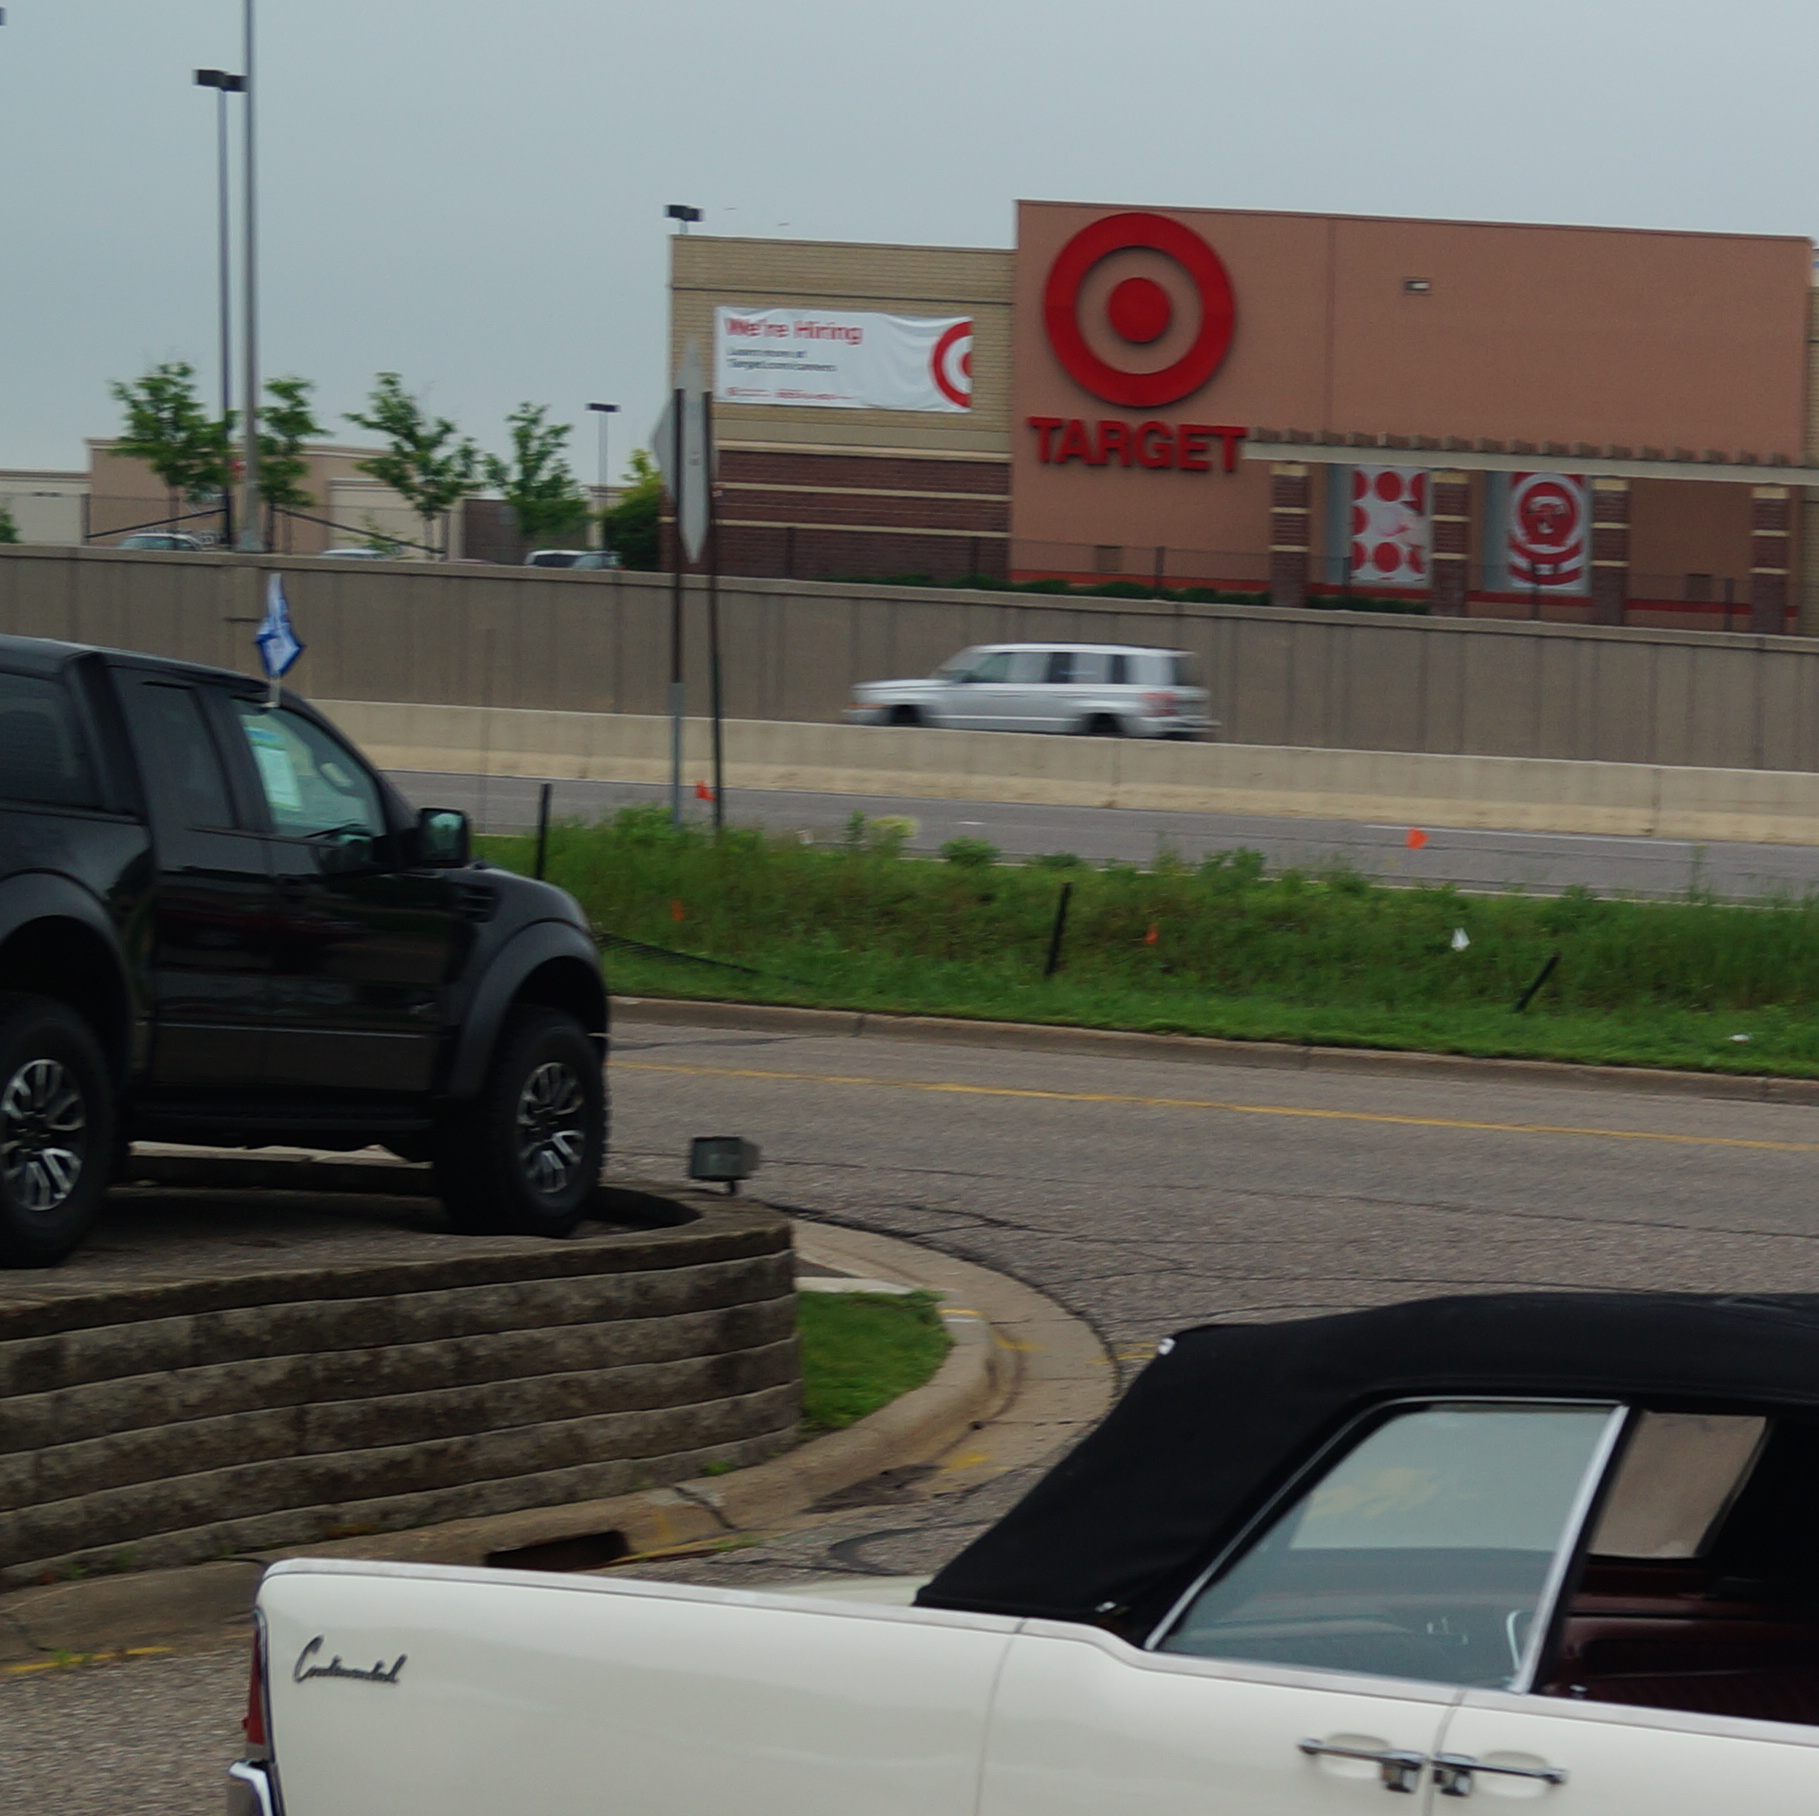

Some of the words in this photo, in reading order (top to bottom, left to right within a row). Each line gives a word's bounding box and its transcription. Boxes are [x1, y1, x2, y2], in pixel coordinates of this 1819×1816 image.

[793, 319, 864, 346] Hiring
[1026, 416, 1249, 472] TARGET
[293, 1634, 408, 1684] Continental
